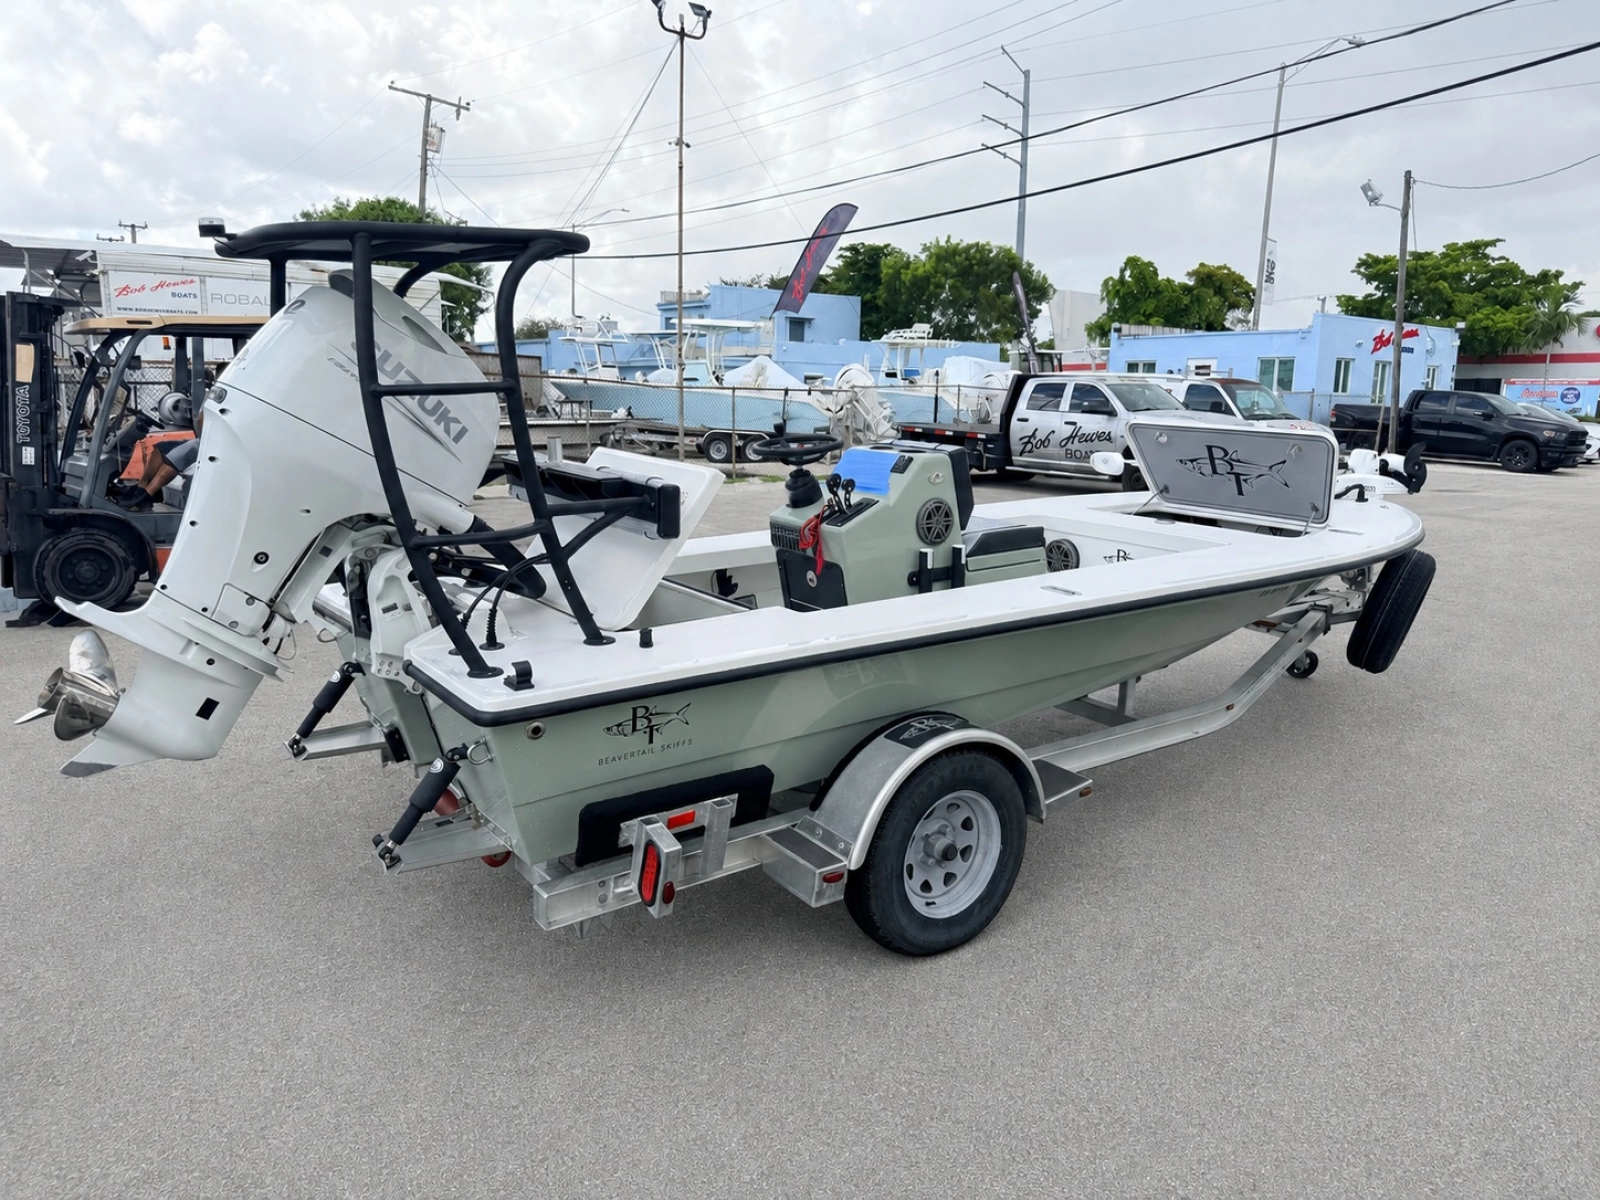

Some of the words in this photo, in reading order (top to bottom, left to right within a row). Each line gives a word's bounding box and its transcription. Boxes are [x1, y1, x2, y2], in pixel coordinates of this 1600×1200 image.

[114, 283, 146, 298] Bob
[150, 278, 196, 292] Hewes
[210, 292, 271, 306] ROBAL
[351, 340, 469, 445] UZUKI
[15, 385, 30, 443] TOYOTA
[1018, 428, 1055, 457] Bob
[1059, 426, 1113, 448] Hewes
[1065, 448, 1099, 460] BOA
[598, 748, 655, 767] BEAVERTAIL
[661, 738, 693, 752] SKIFFS
